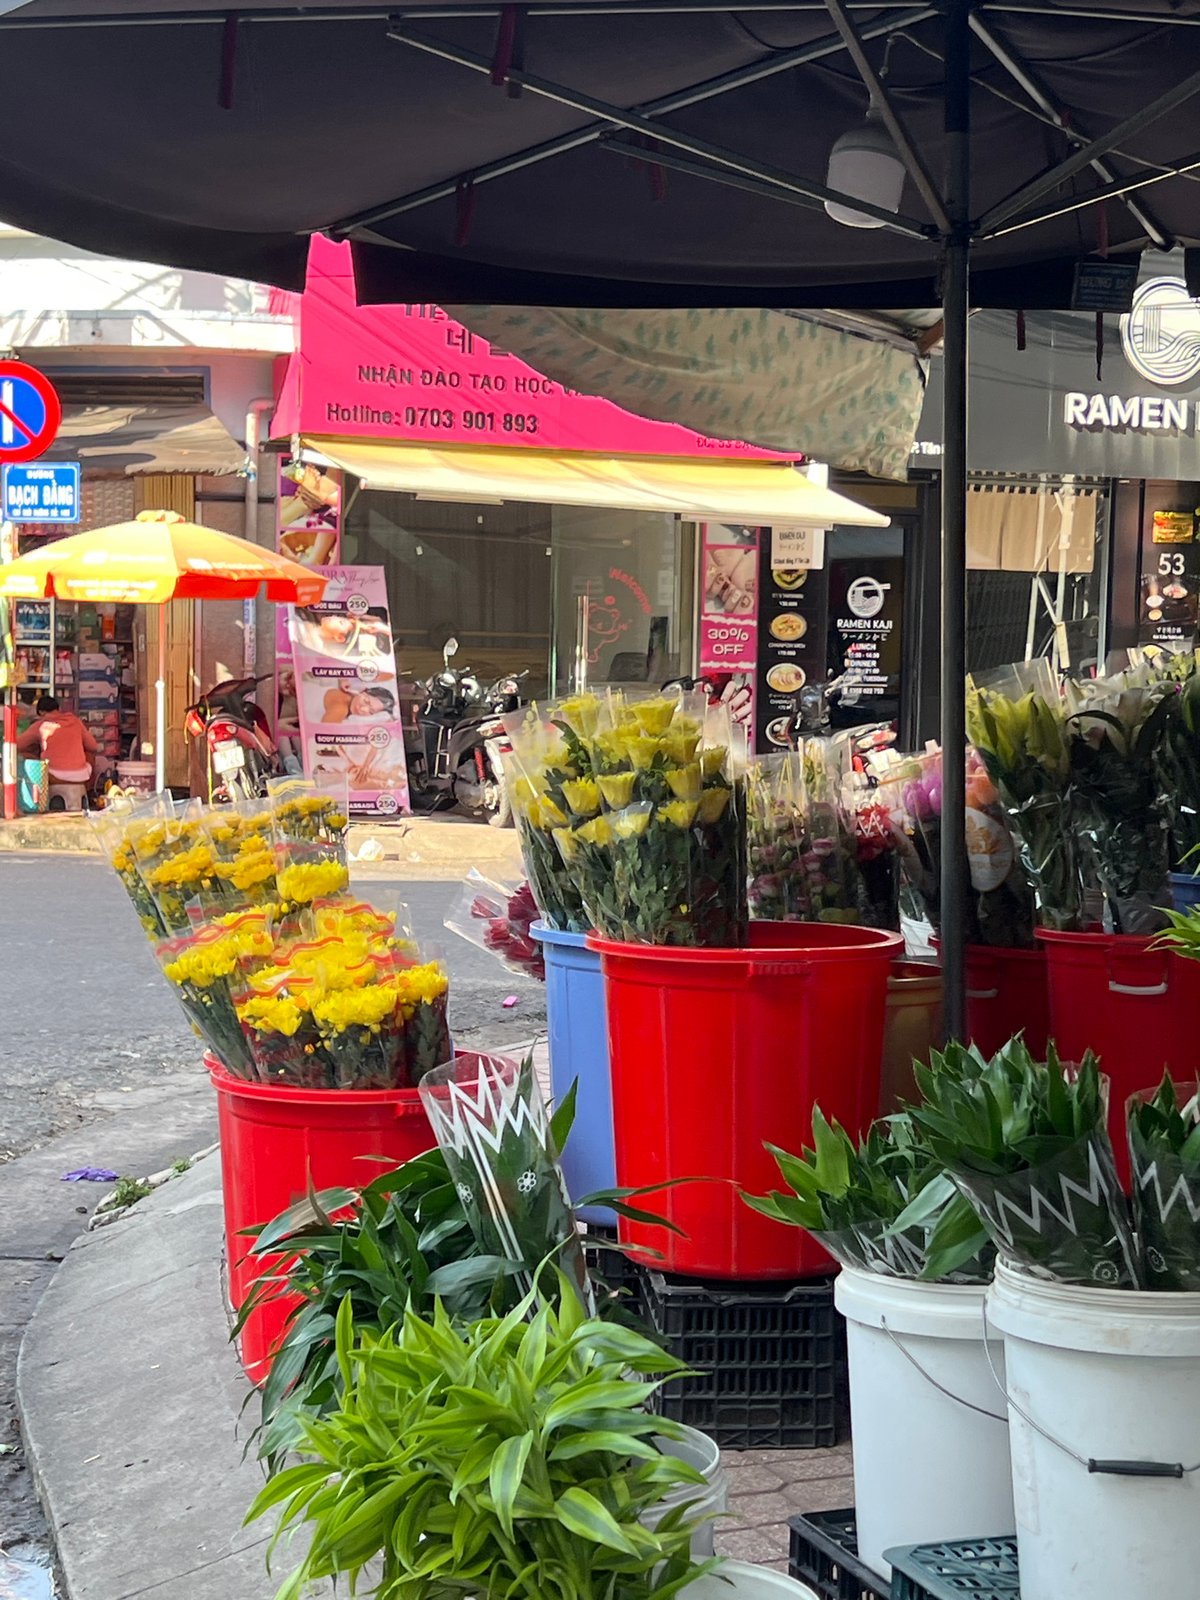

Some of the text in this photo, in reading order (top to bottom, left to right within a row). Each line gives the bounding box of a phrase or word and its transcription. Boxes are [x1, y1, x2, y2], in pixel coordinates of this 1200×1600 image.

[358, 364, 413, 388] NHẬN
[420, 365, 461, 388] ĐÀO
[469, 373, 506, 395] TẠO
[514, 376, 554, 399] HỌC
[327, 403, 538, 434] Hotline: 0703 901 893
[1064, 392, 1188, 431] RAMEN
[8, 479, 74, 508] BẠCH ĐẰNG
[1158, 553, 1185, 575] 53
[349, 600, 367, 609] 250
[836, 619, 893, 629] RAMEN KAJI
[707, 628, 749, 642] 30%
[712, 643, 745, 655] OFF
[370, 732, 388, 742] 250
[378, 800, 396, 808] 250
